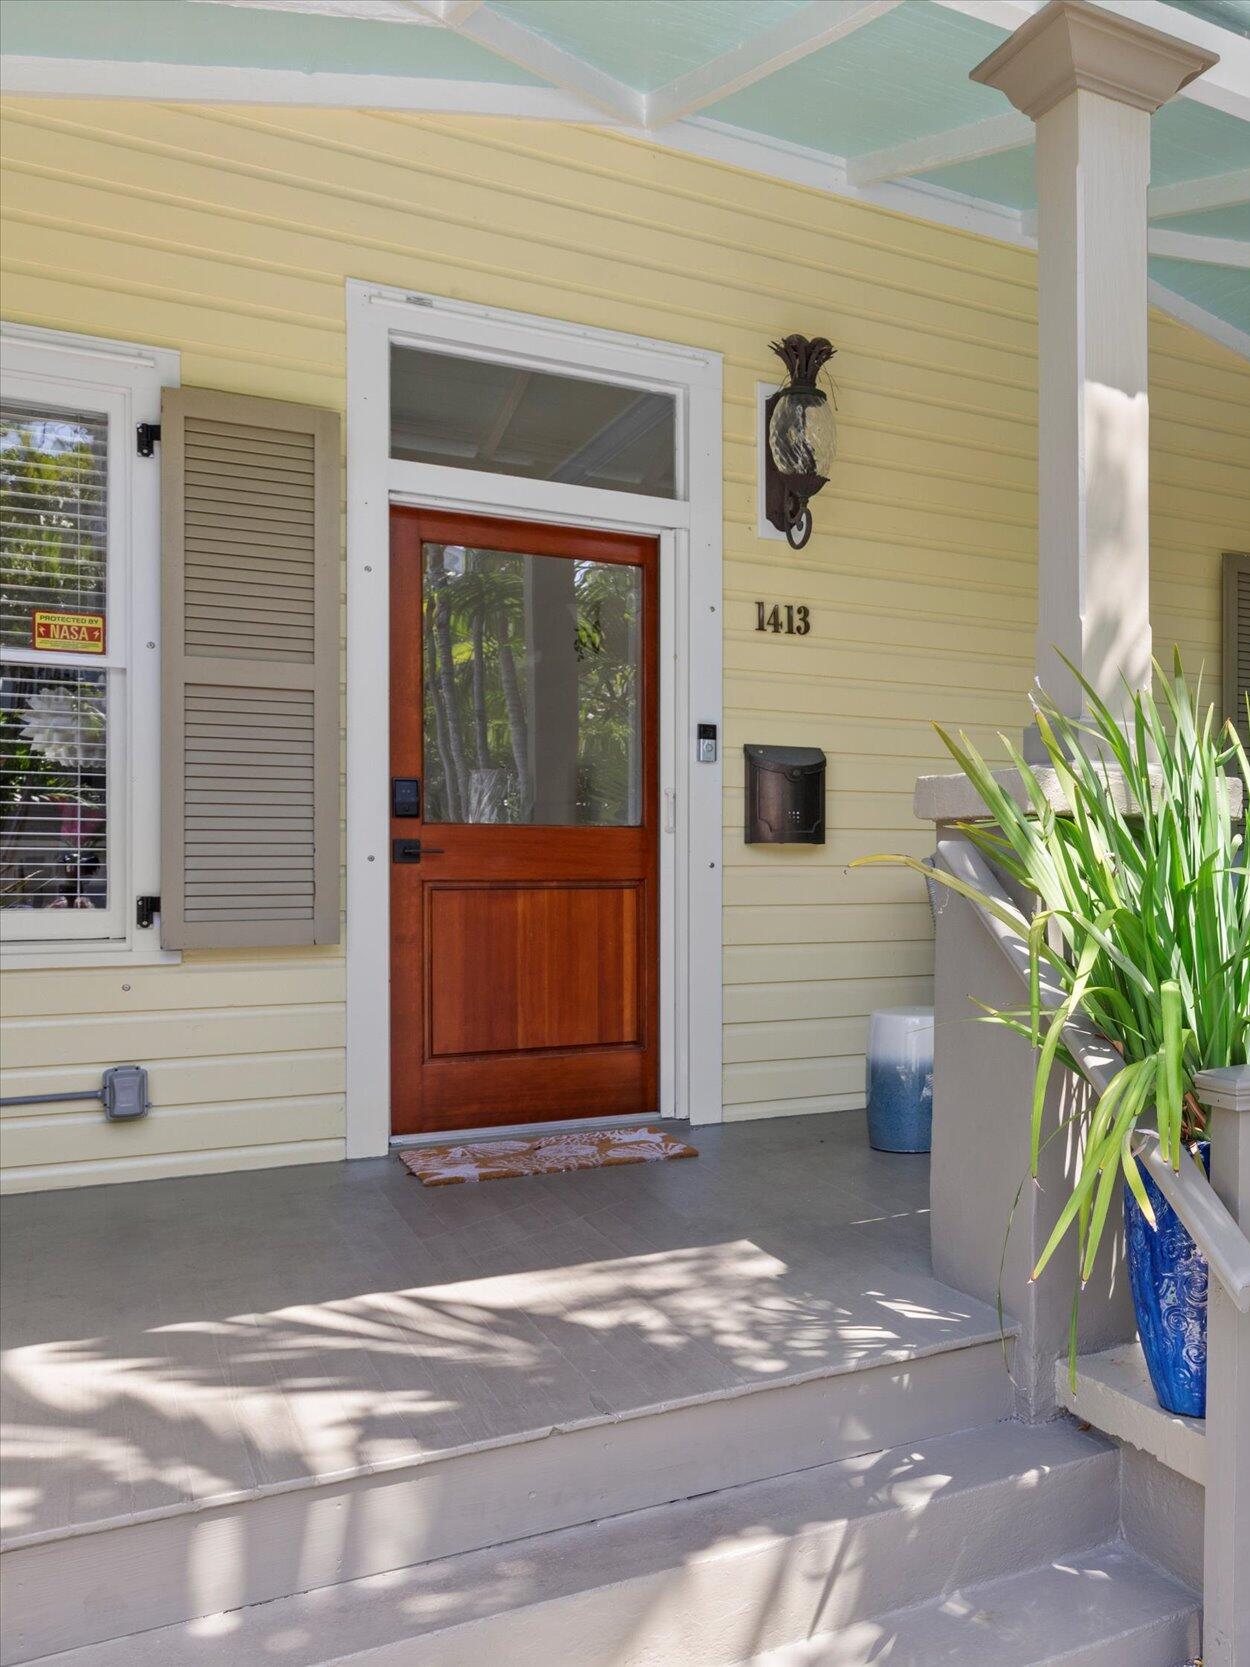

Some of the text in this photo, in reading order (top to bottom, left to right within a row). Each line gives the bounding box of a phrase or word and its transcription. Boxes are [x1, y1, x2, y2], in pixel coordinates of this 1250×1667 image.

[39, 614, 87, 625] PROTECTED
[755, 601, 811, 635] 1413
[50, 624, 89, 640] NASA
